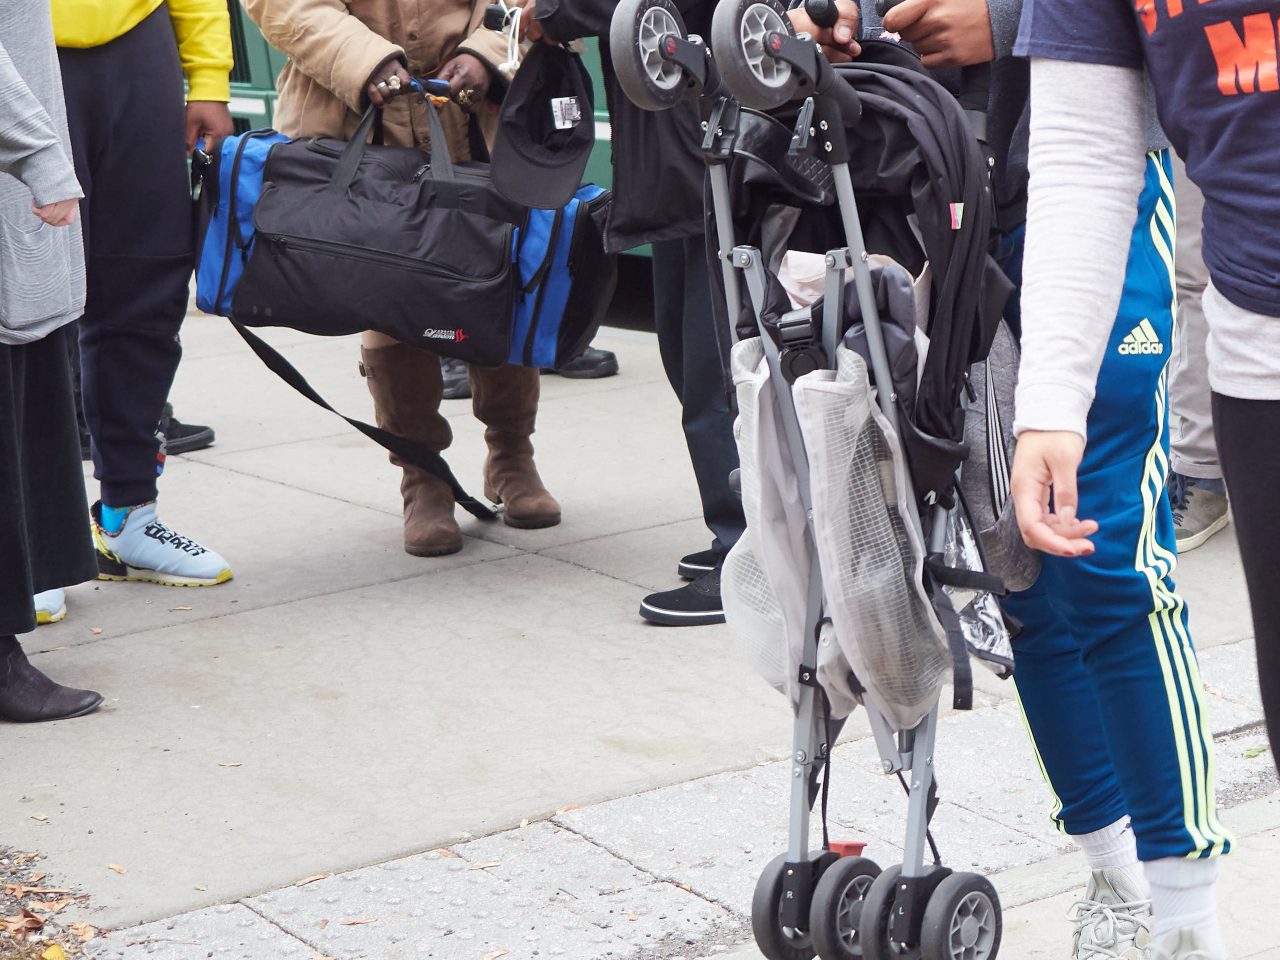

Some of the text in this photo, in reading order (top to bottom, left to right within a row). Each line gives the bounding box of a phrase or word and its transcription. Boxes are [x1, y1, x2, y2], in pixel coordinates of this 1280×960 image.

[1118, 341, 1163, 355] adidas
[786, 890, 793, 899] R
[898, 906, 904, 915] L
